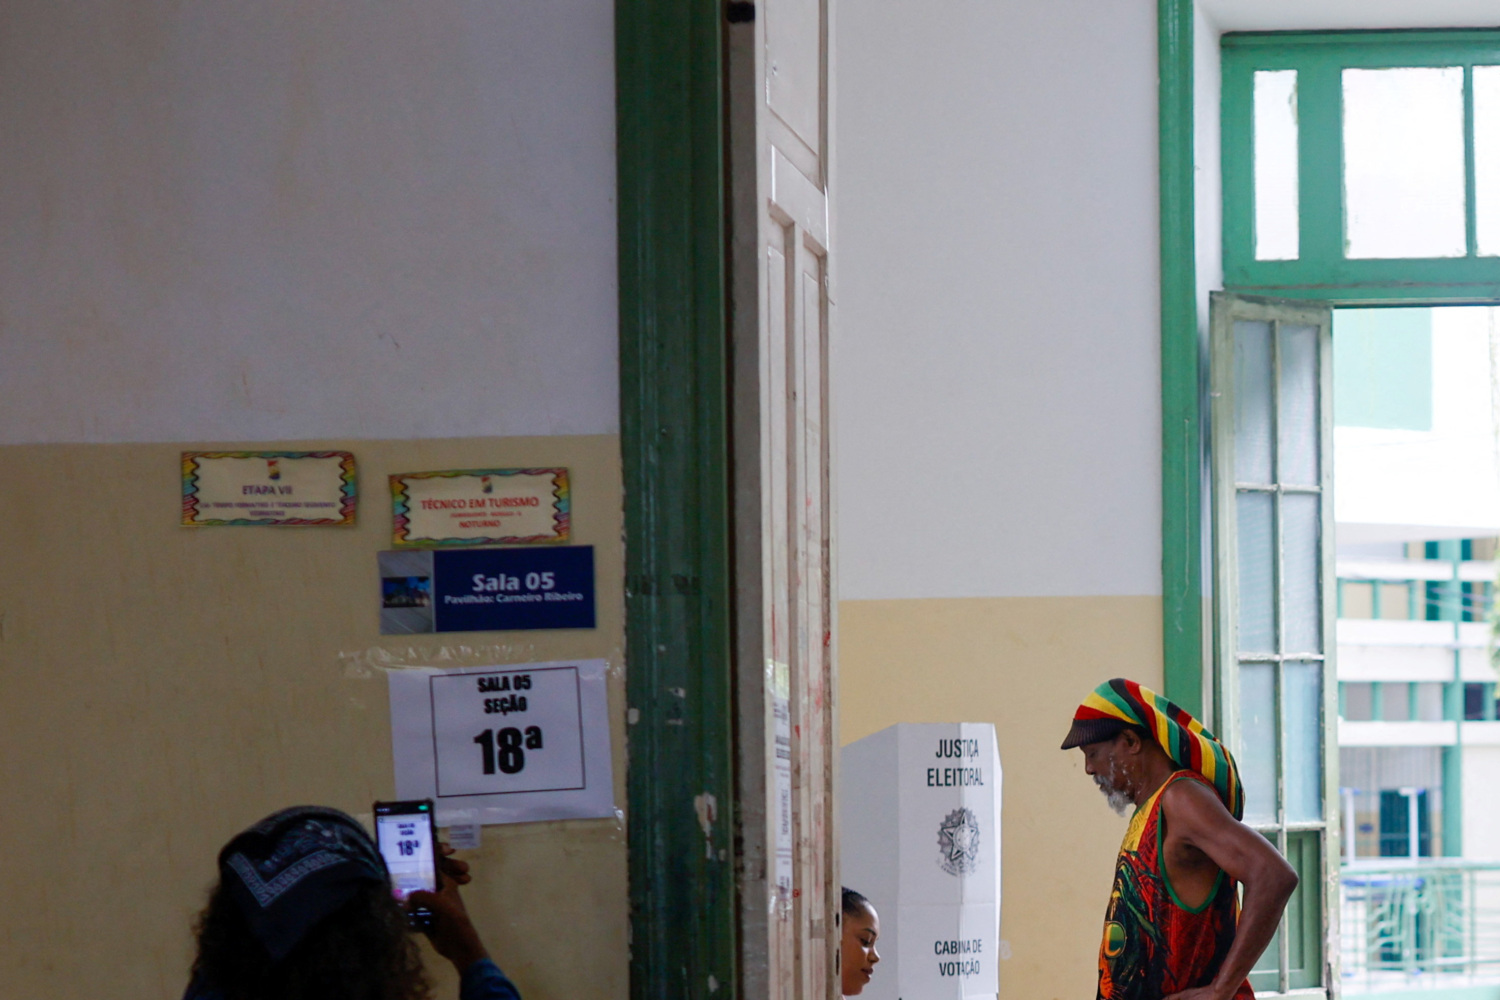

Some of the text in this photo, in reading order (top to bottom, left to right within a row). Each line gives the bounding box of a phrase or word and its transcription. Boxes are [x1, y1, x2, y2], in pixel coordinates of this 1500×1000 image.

[242, 485, 293, 495] ETAPA VII
[420, 496, 540, 510] TÉCNICO EM TURISMO
[459, 520, 501, 528] NOTURNO
[472, 571, 555, 592] Sala 05
[496, 593, 542, 603] Carneiro
[544, 591, 584, 602] Ribeiro
[477, 674, 532, 692] SALA 05
[483, 694, 528, 716] SEÇÃO
[935, 739, 979, 763] JUSTIÇA
[927, 767, 984, 787] ELEITORAL
[934, 939, 982, 955] CABINA DE
[939, 958, 980, 979] VOTAÇÃO
